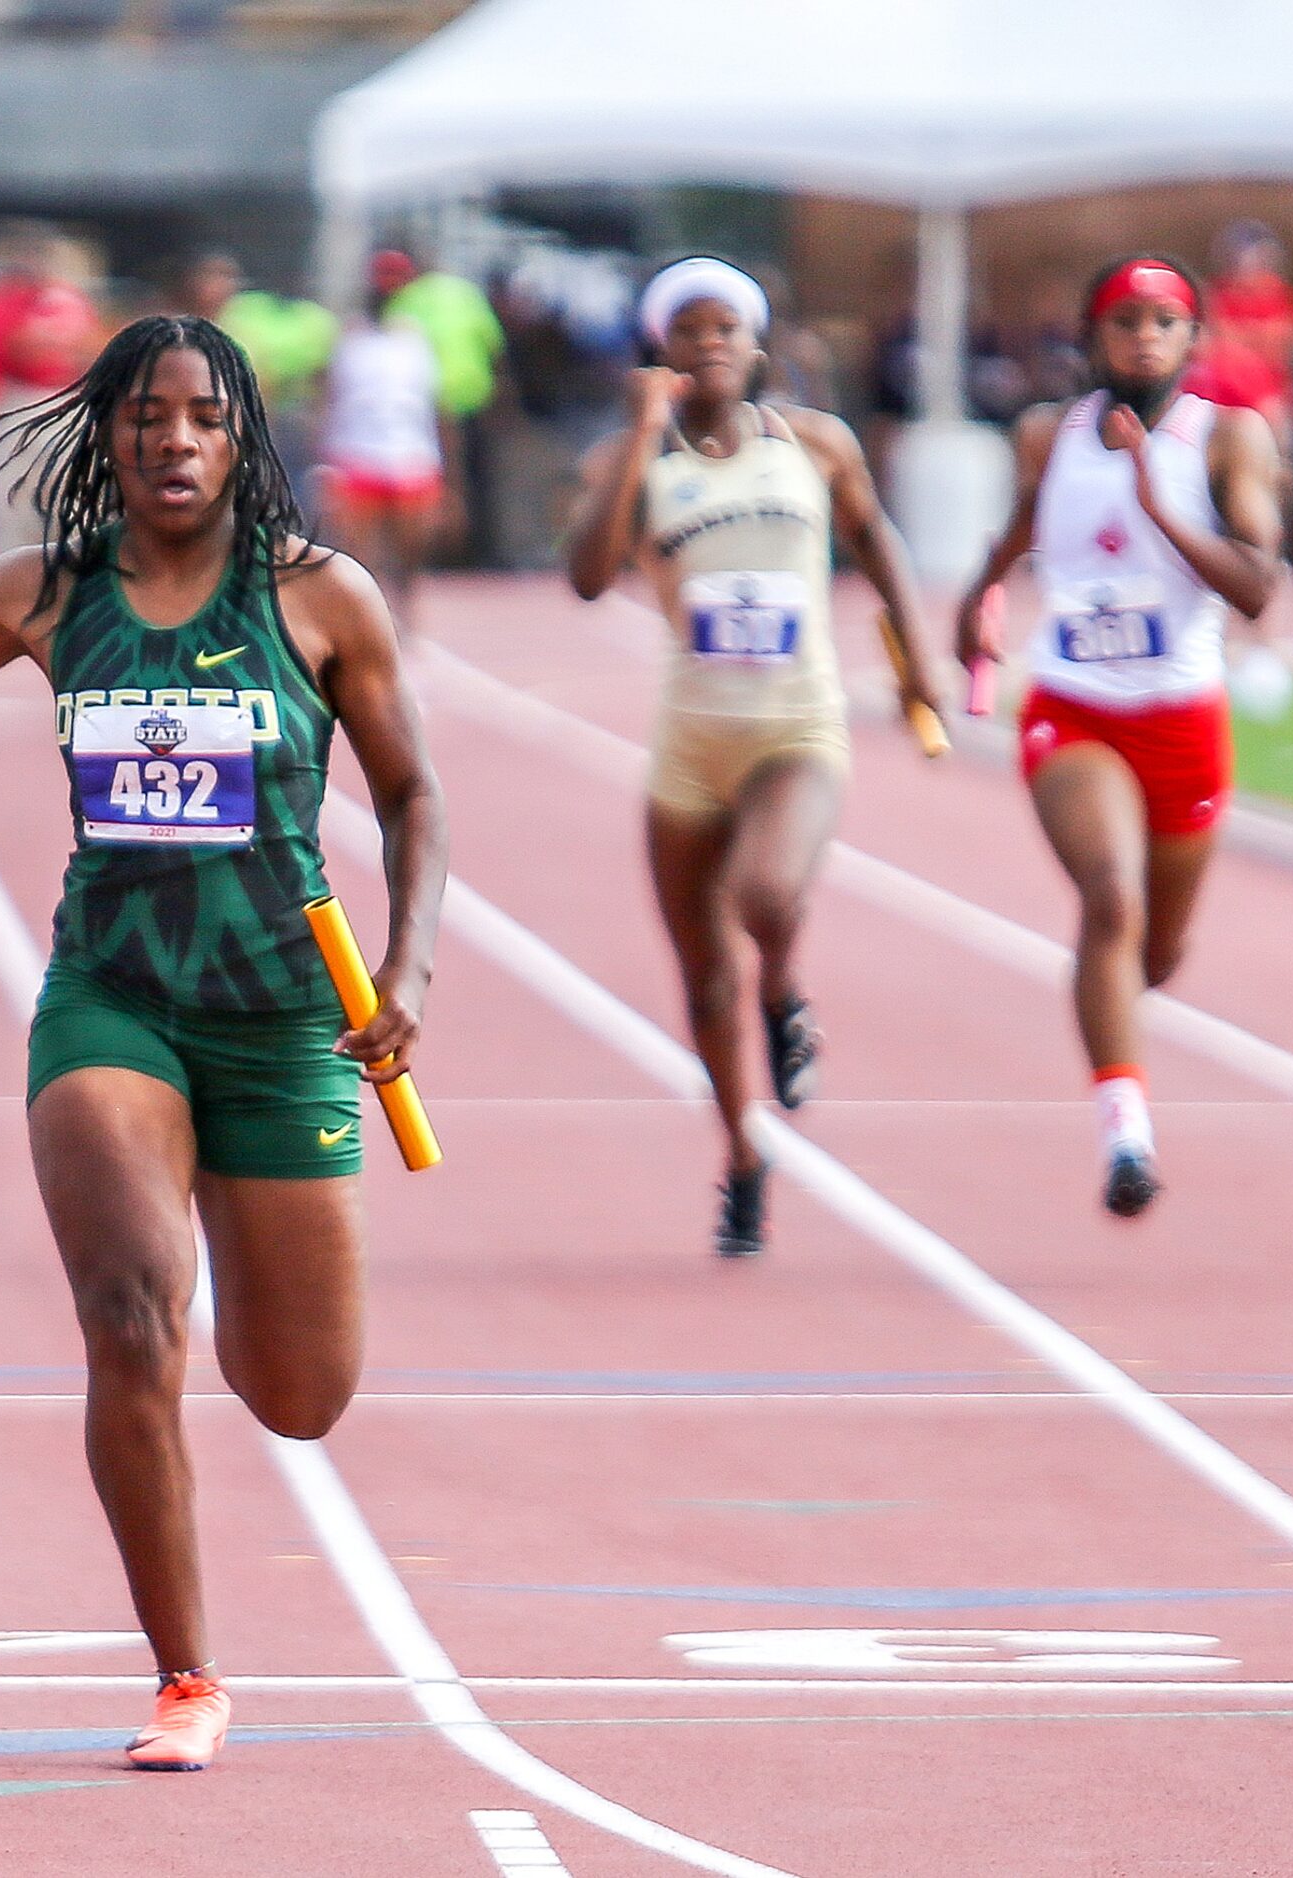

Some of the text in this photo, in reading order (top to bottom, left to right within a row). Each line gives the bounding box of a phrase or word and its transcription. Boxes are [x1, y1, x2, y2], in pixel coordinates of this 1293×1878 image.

[135, 726, 187, 741] STATE
[109, 759, 219, 818] 432
[149, 826, 177, 838] 2021
